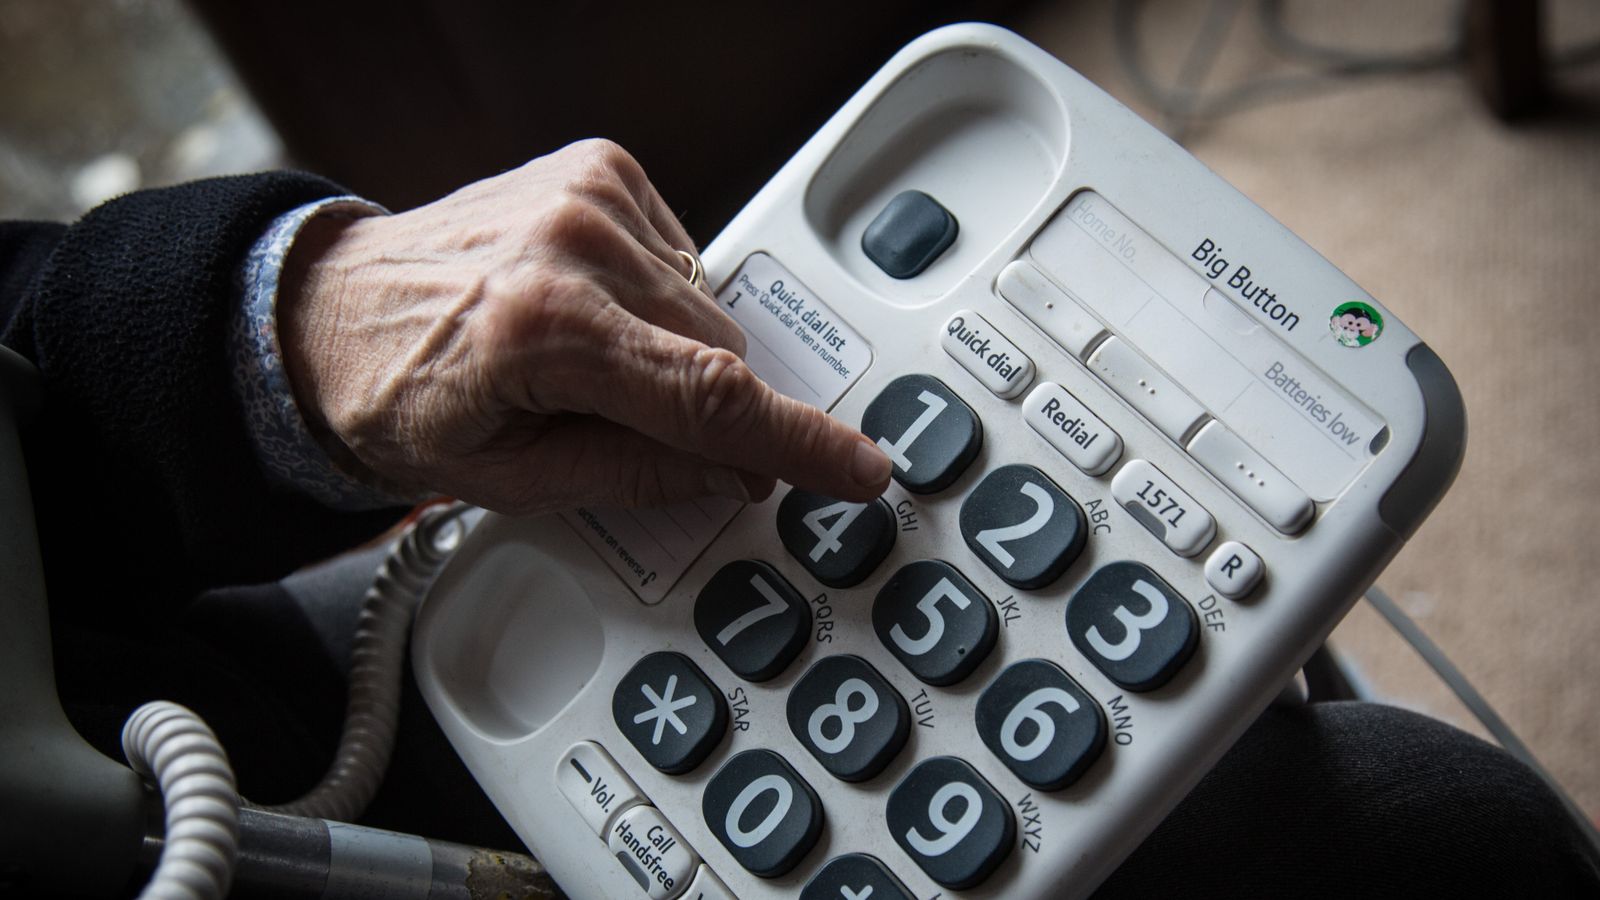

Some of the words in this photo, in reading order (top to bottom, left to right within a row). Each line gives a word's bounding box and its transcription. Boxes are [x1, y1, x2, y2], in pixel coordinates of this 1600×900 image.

[727, 292, 742, 309] 1
[770, 280, 804, 315] Quick
[801, 310, 826, 335] dial
[822, 324, 846, 352] list
[1191, 238, 1229, 280] Big
[1227, 265, 1300, 332] Button
[738, 274, 760, 297] Press
[795, 326, 814, 348] then
[817, 348, 850, 379] number.
[946, 316, 991, 360] Quick
[986, 349, 1023, 383] dial
[876, 390, 948, 473] 1
[1040, 397, 1100, 450] Redial
[1264, 361, 1331, 424] Batteries
[1325, 413, 1361, 447] low
[802, 500, 868, 563] 4
[896, 500, 918, 533] GHI
[975, 481, 1054, 569] 2
[1086, 498, 1111, 535] ABC
[1136, 480, 1187, 528] 1571
[575, 506, 607, 539] uctions
[604, 535, 619, 551] on
[616, 546, 646, 578] reverse
[1221, 554, 1243, 579] R
[716, 573, 790, 647] 7
[811, 593, 834, 644] PQRS
[889, 577, 972, 656] 5
[996, 594, 1021, 628] JKL
[1085, 579, 1169, 661] 3
[1198, 594, 1226, 633] DEF
[727, 687, 750, 732] STAR
[807, 677, 879, 754] 8
[910, 689, 935, 730] TUV
[1000, 686, 1081, 761] 6
[1106, 695, 1133, 746] MNO
[590, 777, 617, 813] Vol.
[725, 774, 793, 848] 0
[905, 781, 983, 857] 9
[1017, 793, 1043, 854] WXYZ
[614, 819, 675, 891] Handsfree
[646, 824, 676, 855] Call
